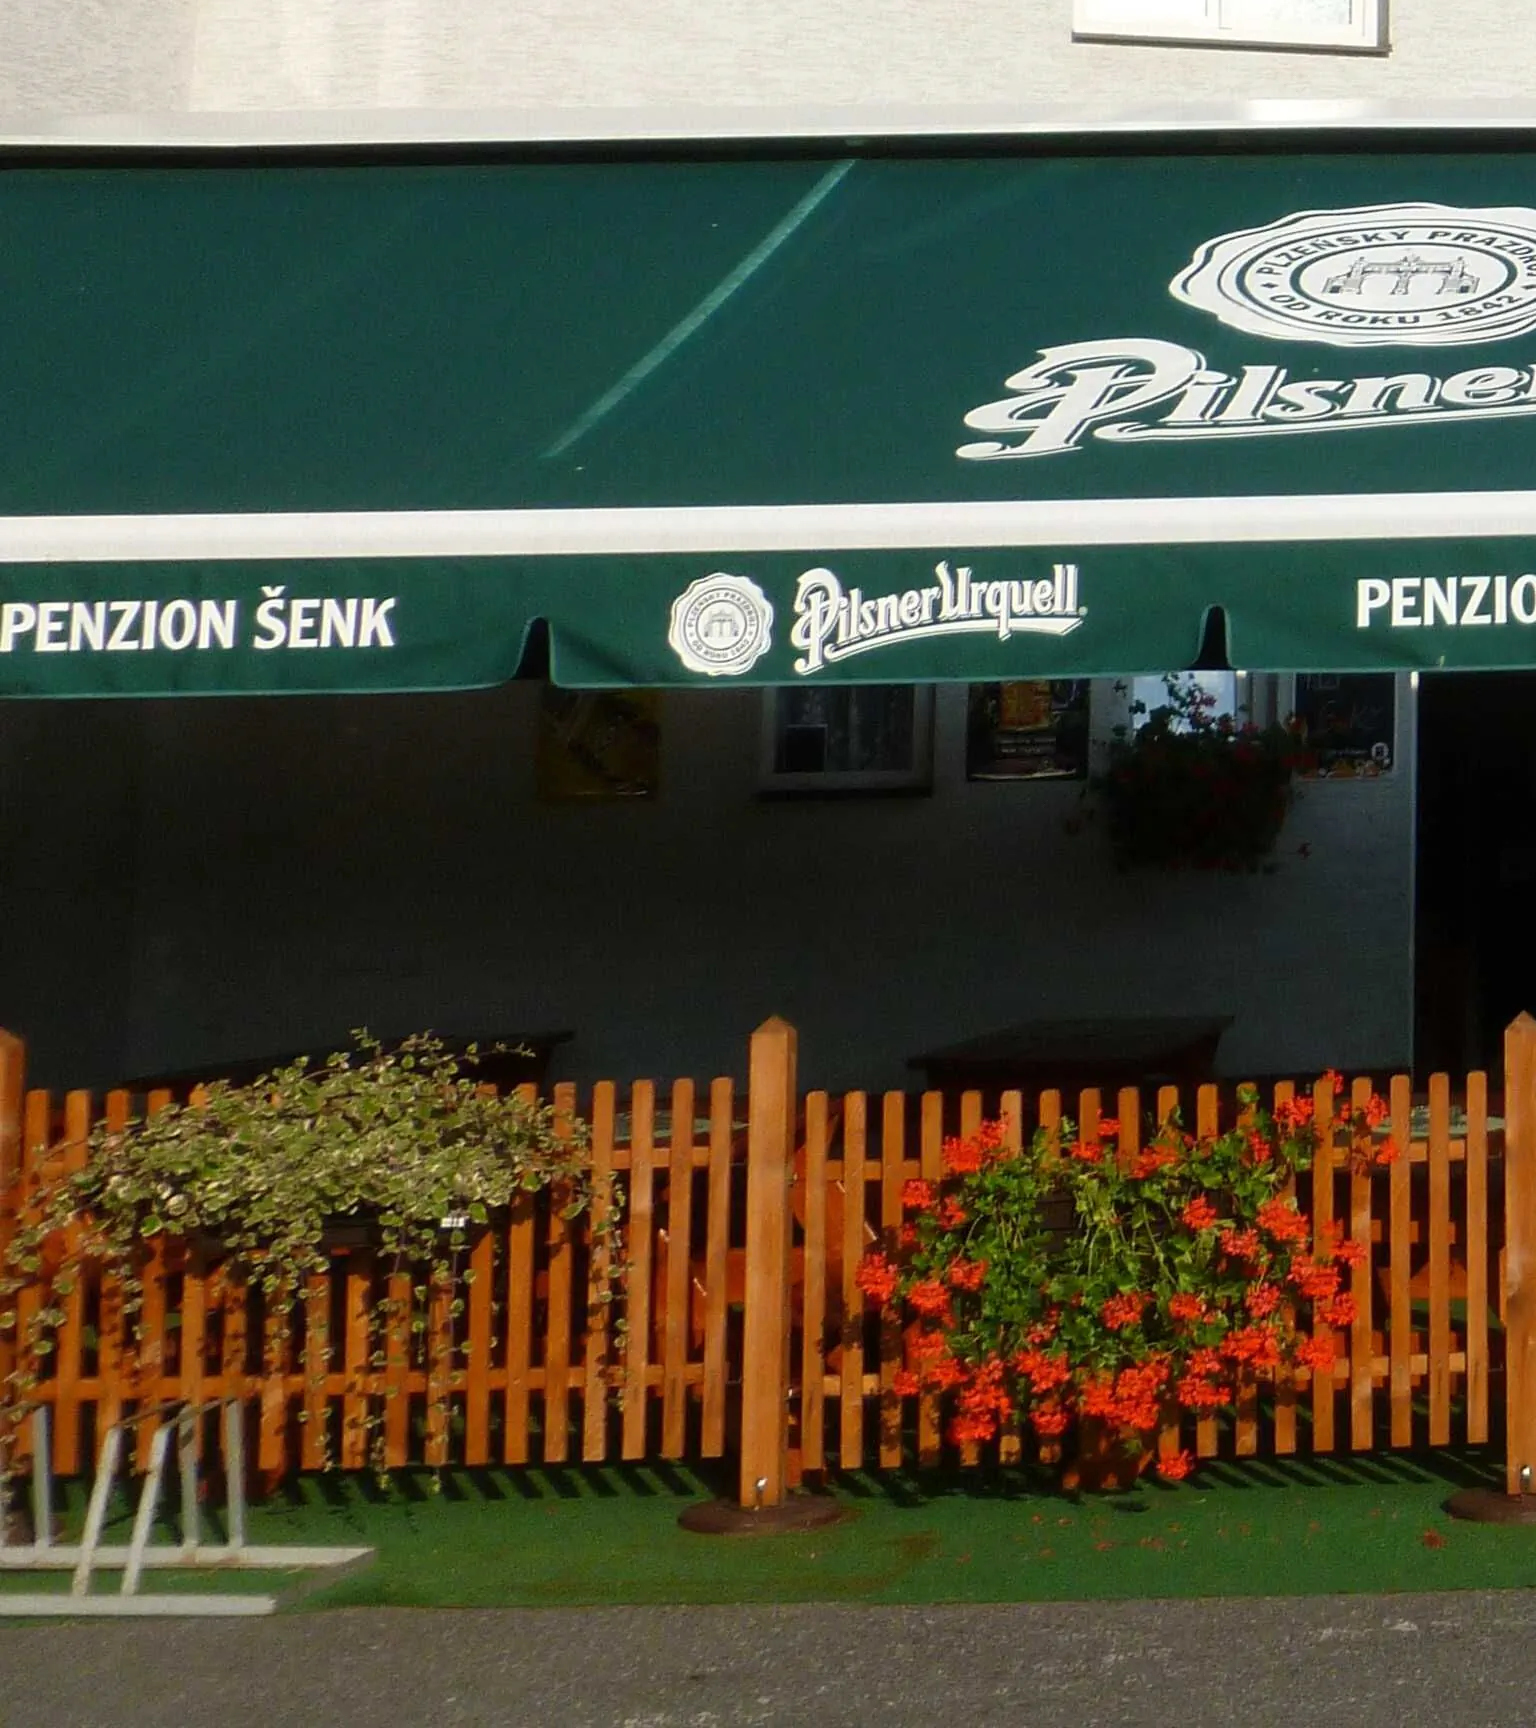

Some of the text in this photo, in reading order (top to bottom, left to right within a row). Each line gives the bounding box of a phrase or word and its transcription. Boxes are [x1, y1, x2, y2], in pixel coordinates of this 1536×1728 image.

[1269, 293, 1524, 325] OD ROKU 1842
[0, 586, 396, 652] PENZION ŠENK
[791, 560, 1081, 675] Pilsner Urquell
